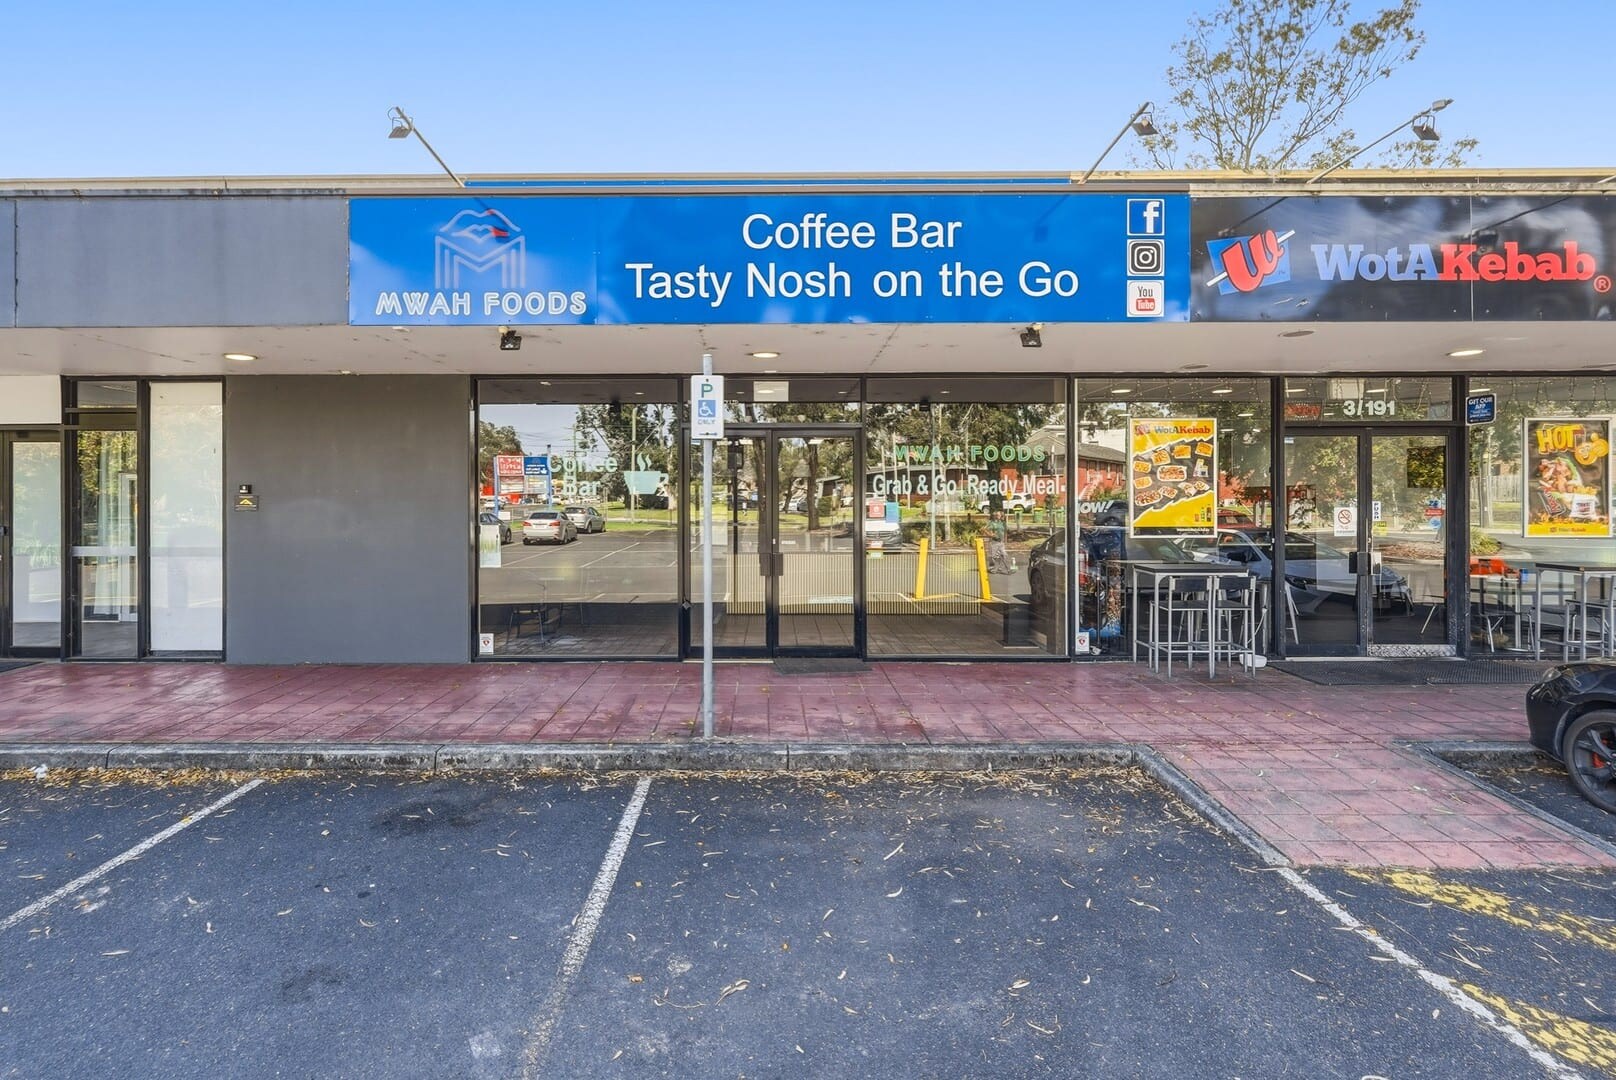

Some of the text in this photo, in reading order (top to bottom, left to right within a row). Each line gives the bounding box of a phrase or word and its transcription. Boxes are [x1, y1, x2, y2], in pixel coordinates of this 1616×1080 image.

[742, 212, 962, 250] Coffee Bar
[1310, 240, 1596, 282] WotAKebab
[625, 261, 1079, 308] Tasty Nosh on the Go
[1137, 286, 1153, 297] You
[375, 291, 587, 315] MWAH FOODS
[1137, 299, 1154, 310] Tube
[701, 383, 713, 398] P
[1343, 400, 1395, 416] 3/191
[1536, 424, 1583, 453] HOT
[894, 445, 1046, 462] MWAH FOODS
[562, 479, 601, 496] Bar
[873, 474, 912, 495] Grab
[916, 474, 929, 495] &
[934, 474, 957, 495] Go
[968, 475, 1018, 500] Ready
[1077, 500, 1114, 514] OW!
